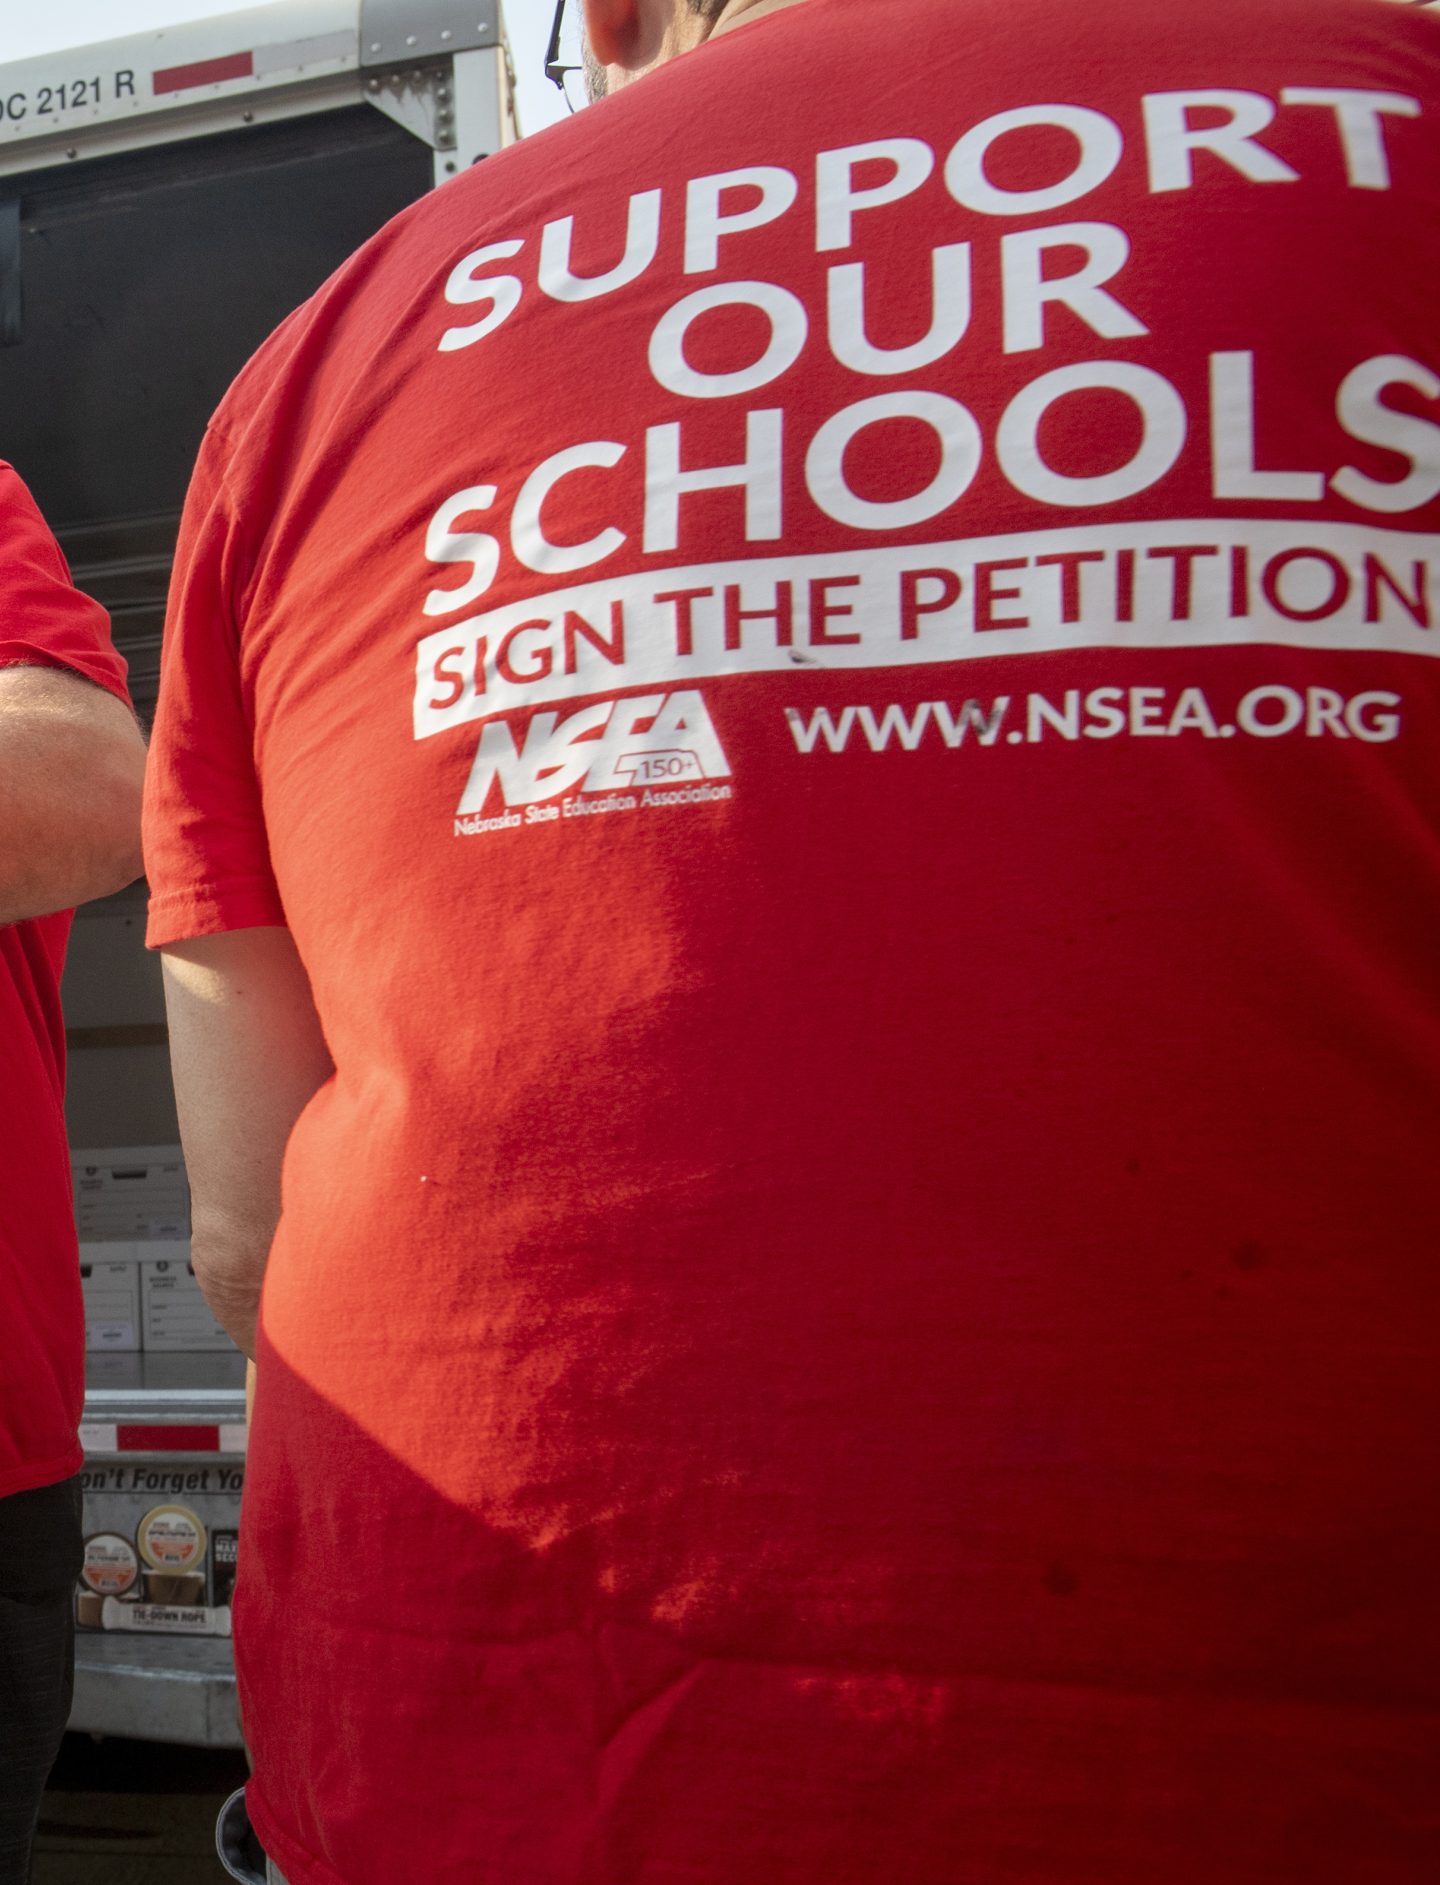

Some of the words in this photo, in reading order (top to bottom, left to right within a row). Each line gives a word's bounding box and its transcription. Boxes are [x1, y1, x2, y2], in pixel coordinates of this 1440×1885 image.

[37, 76, 100, 115] 2121
[115, 69, 135, 98] R
[437, 88, 1422, 352] SUPPORT
[648, 221, 1150, 399] OUR
[420, 350, 1440, 618] SCHOOLS
[428, 599, 626, 710] SIGN
[652, 574, 862, 656] THE
[899, 545, 1431, 643] PETITION
[455, 689, 733, 816] NSEA
[785, 685, 1399, 753] WWW.NSEA.ORG
[640, 757, 694, 779] 150+
[453, 809, 521, 837] Nebraska
[524, 805, 560, 826] State
[562, 793, 636, 818] Education
[639, 782, 733, 806] Association
[81, 1468, 124, 1489] on't
[132, 1468, 210, 1495] Forget
[218, 1468, 244, 1489] Yo
[133, 1608, 179, 1621] TIE-DOWN
[180, 1609, 207, 1624] ROPE
